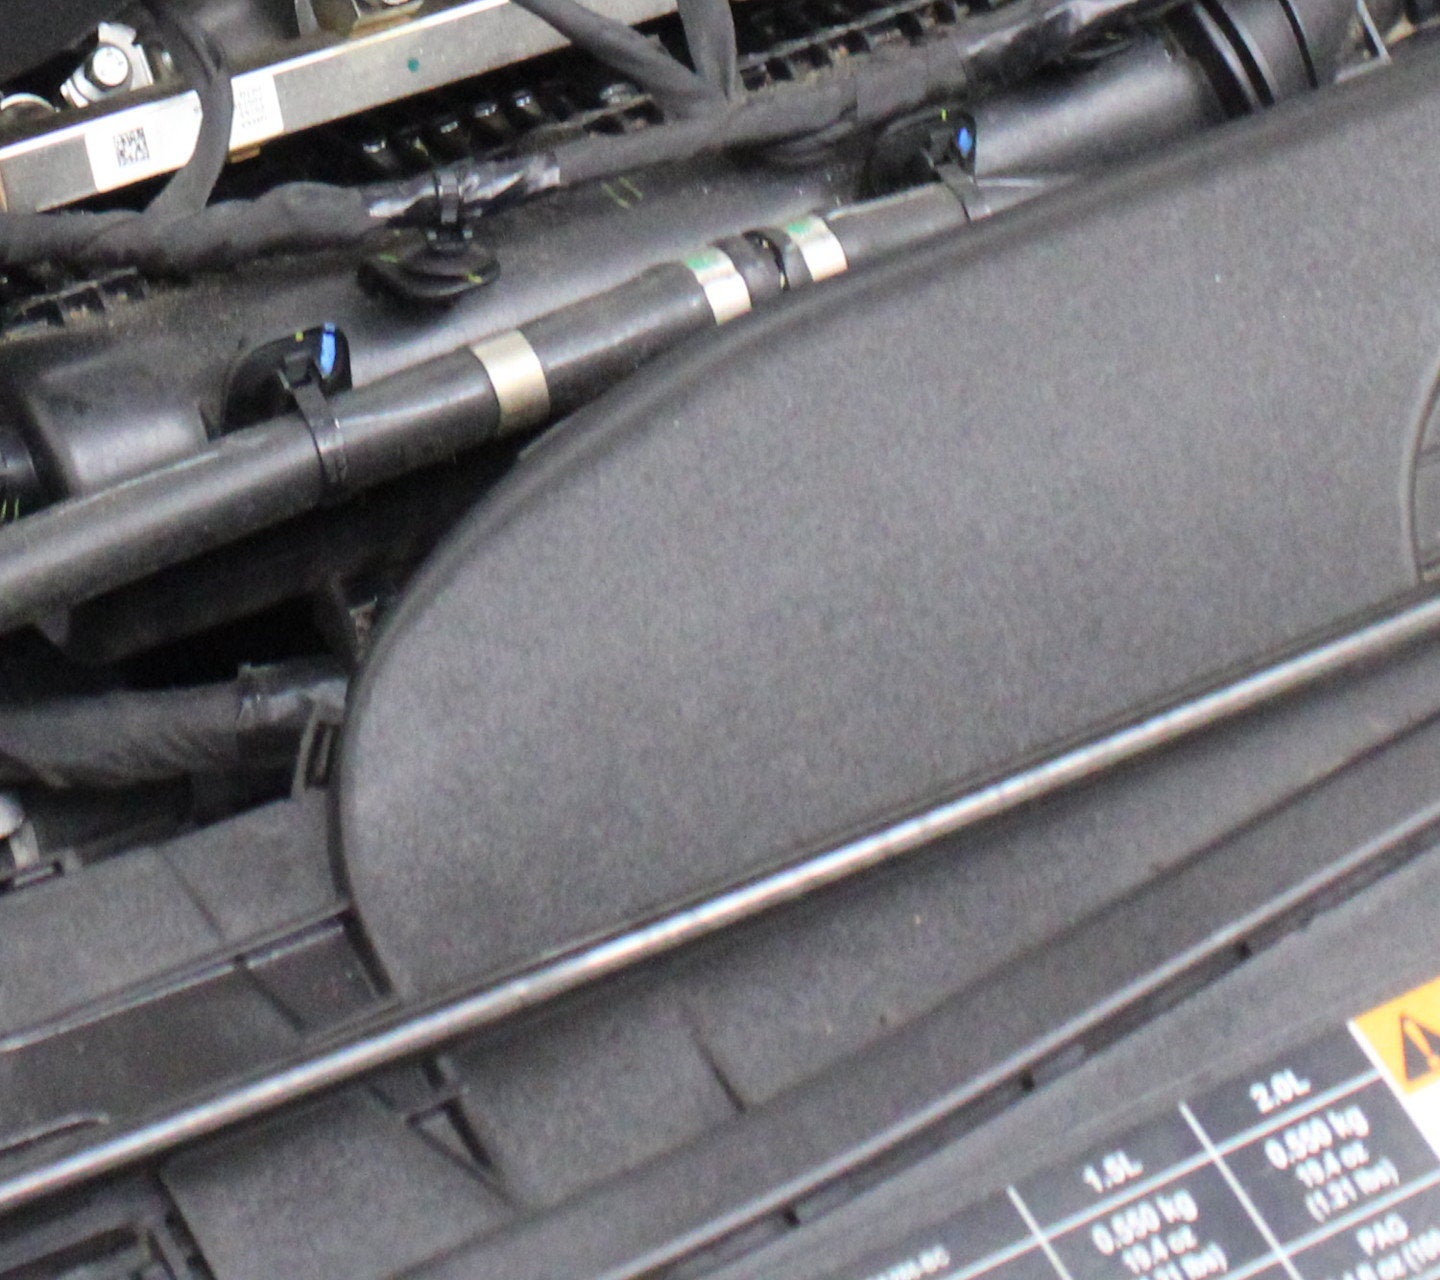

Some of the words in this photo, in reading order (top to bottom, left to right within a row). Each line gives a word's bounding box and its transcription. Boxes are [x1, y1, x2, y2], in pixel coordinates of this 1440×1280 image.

[1249, 1068, 1312, 1114] 2.0L
[1326, 1104, 1370, 1139] kg
[1083, 1151, 1144, 1194] 1.5L
[1338, 1139, 1370, 1170] oz
[1352, 1155, 1401, 1196] lbs)
[1155, 1189, 1199, 1224] kg
[1166, 1224, 1199, 1255] oz
[1355, 1212, 1410, 1257] PAG
